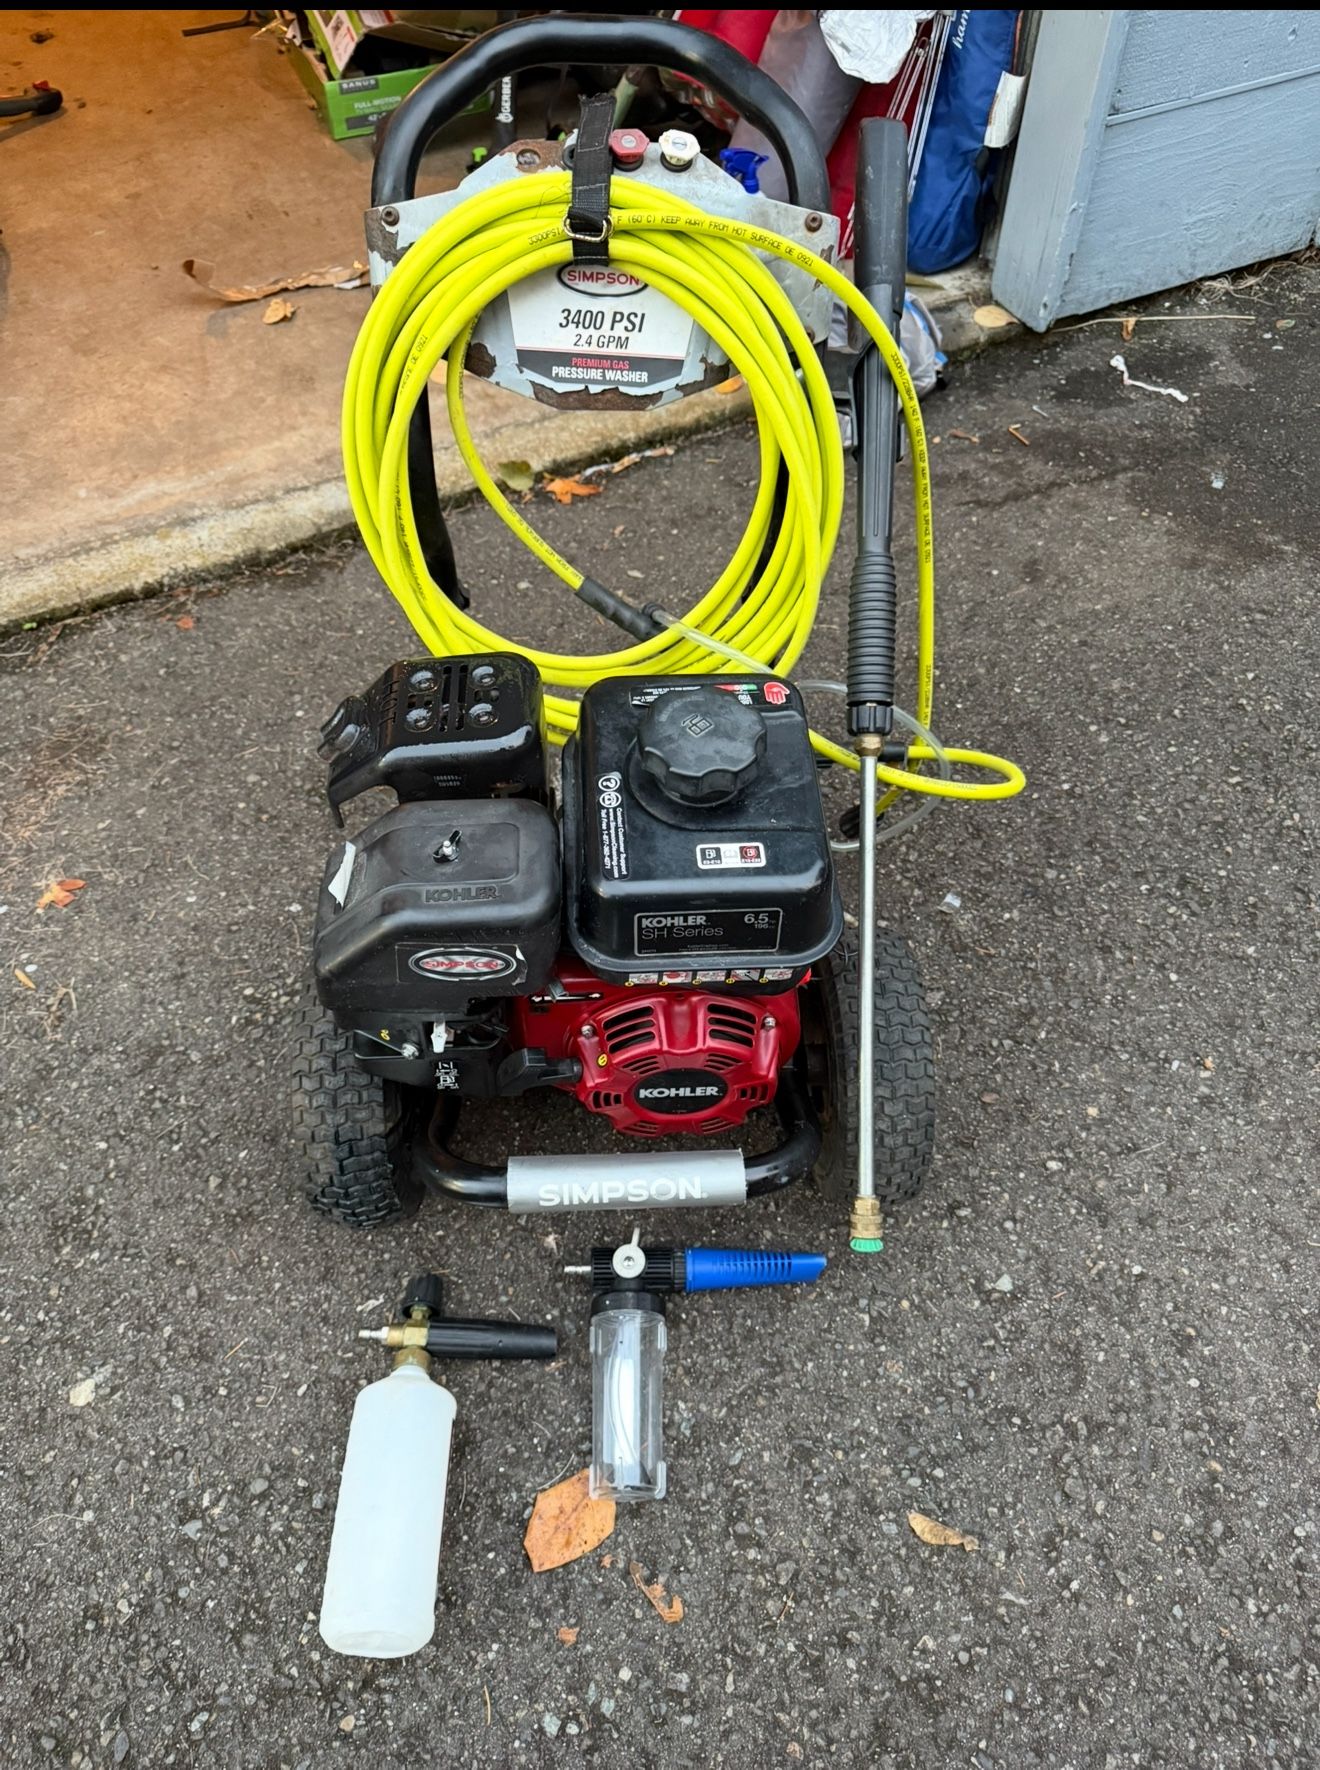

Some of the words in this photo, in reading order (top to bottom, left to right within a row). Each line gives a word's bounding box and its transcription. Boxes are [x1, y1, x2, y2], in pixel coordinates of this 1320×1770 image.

[661, 215, 682, 225] KEEP
[708, 220, 730, 233] FROM
[731, 226, 748, 237] HOT
[750, 231, 783, 250] SURFACE
[567, 269, 640, 287] SIMPSON
[558, 308, 605, 331] 3400
[610, 310, 646, 333] PSI
[573, 333, 593, 348] 2.4
[596, 334, 630, 350] GPM
[571, 357, 611, 369] PREMIUM
[612, 359, 630, 370] GAS
[551, 366, 604, 380] PRESSURE
[604, 368, 649, 383] WASHER
[425, 885, 498, 903] KOHLER
[641, 915, 707, 928] KOHLER
[744, 913, 769, 924] 6.5
[641, 927, 667, 940] SH
[672, 926, 724, 938] Series
[423, 960, 499, 970] SIMPSON
[639, 1086, 720, 1099] KOHLER
[537, 1176, 704, 1207] SIMPSON
